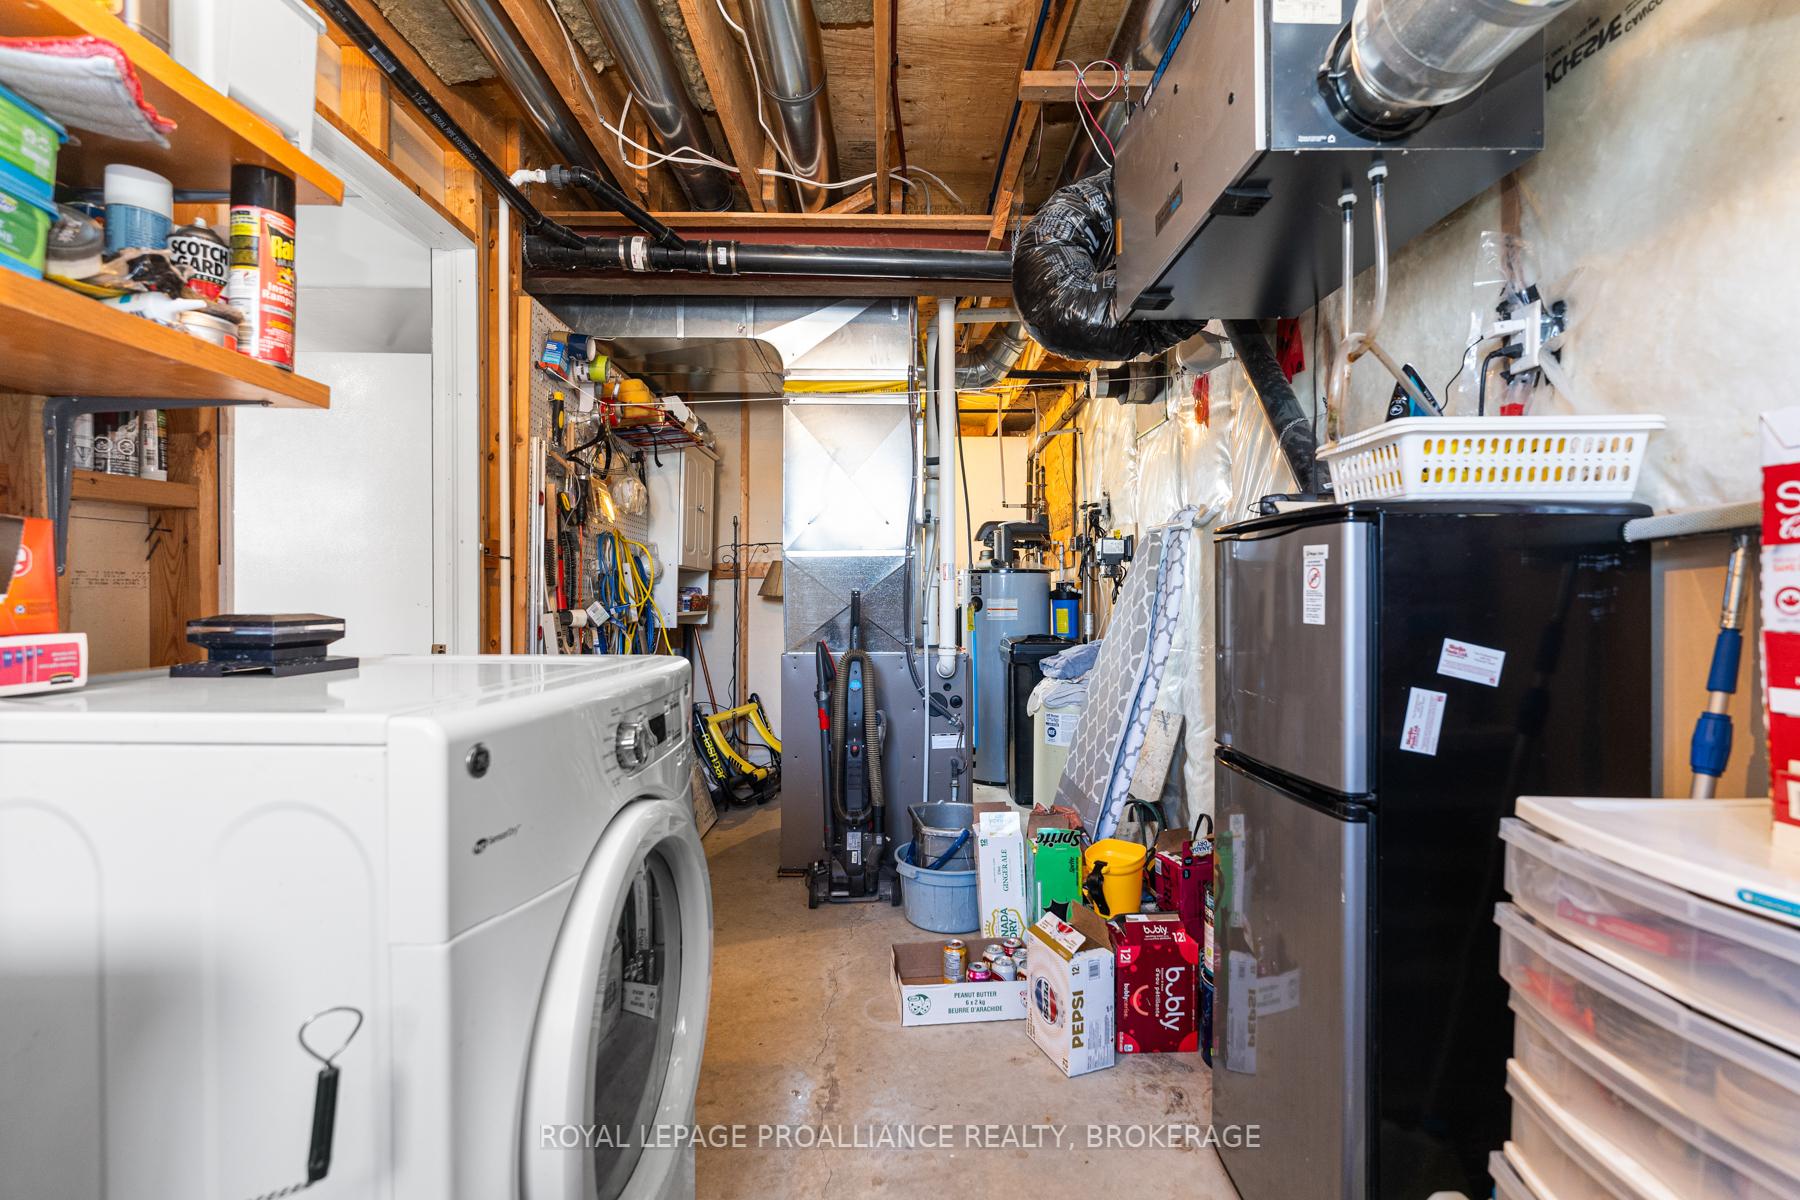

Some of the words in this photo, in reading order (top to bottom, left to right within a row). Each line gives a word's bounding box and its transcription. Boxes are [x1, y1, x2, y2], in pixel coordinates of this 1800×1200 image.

[171, 239, 229, 266] SCOTCH
[1036, 830, 1082, 848] Sprite
[1143, 924, 1168, 936] bubly
[1172, 932, 1182, 943] 12
[1120, 948, 1131, 960] 12
[1072, 966, 1080, 976] 12
[954, 991, 975, 999] PEANUT
[976, 990, 997, 998] BUTTER
[1160, 966, 1185, 1031] bubly
[948, 1006, 970, 1014] BEURRE
[970, 1005, 1003, 1013] D'ARACHIDE
[1072, 990, 1084, 1049] PEPSI
